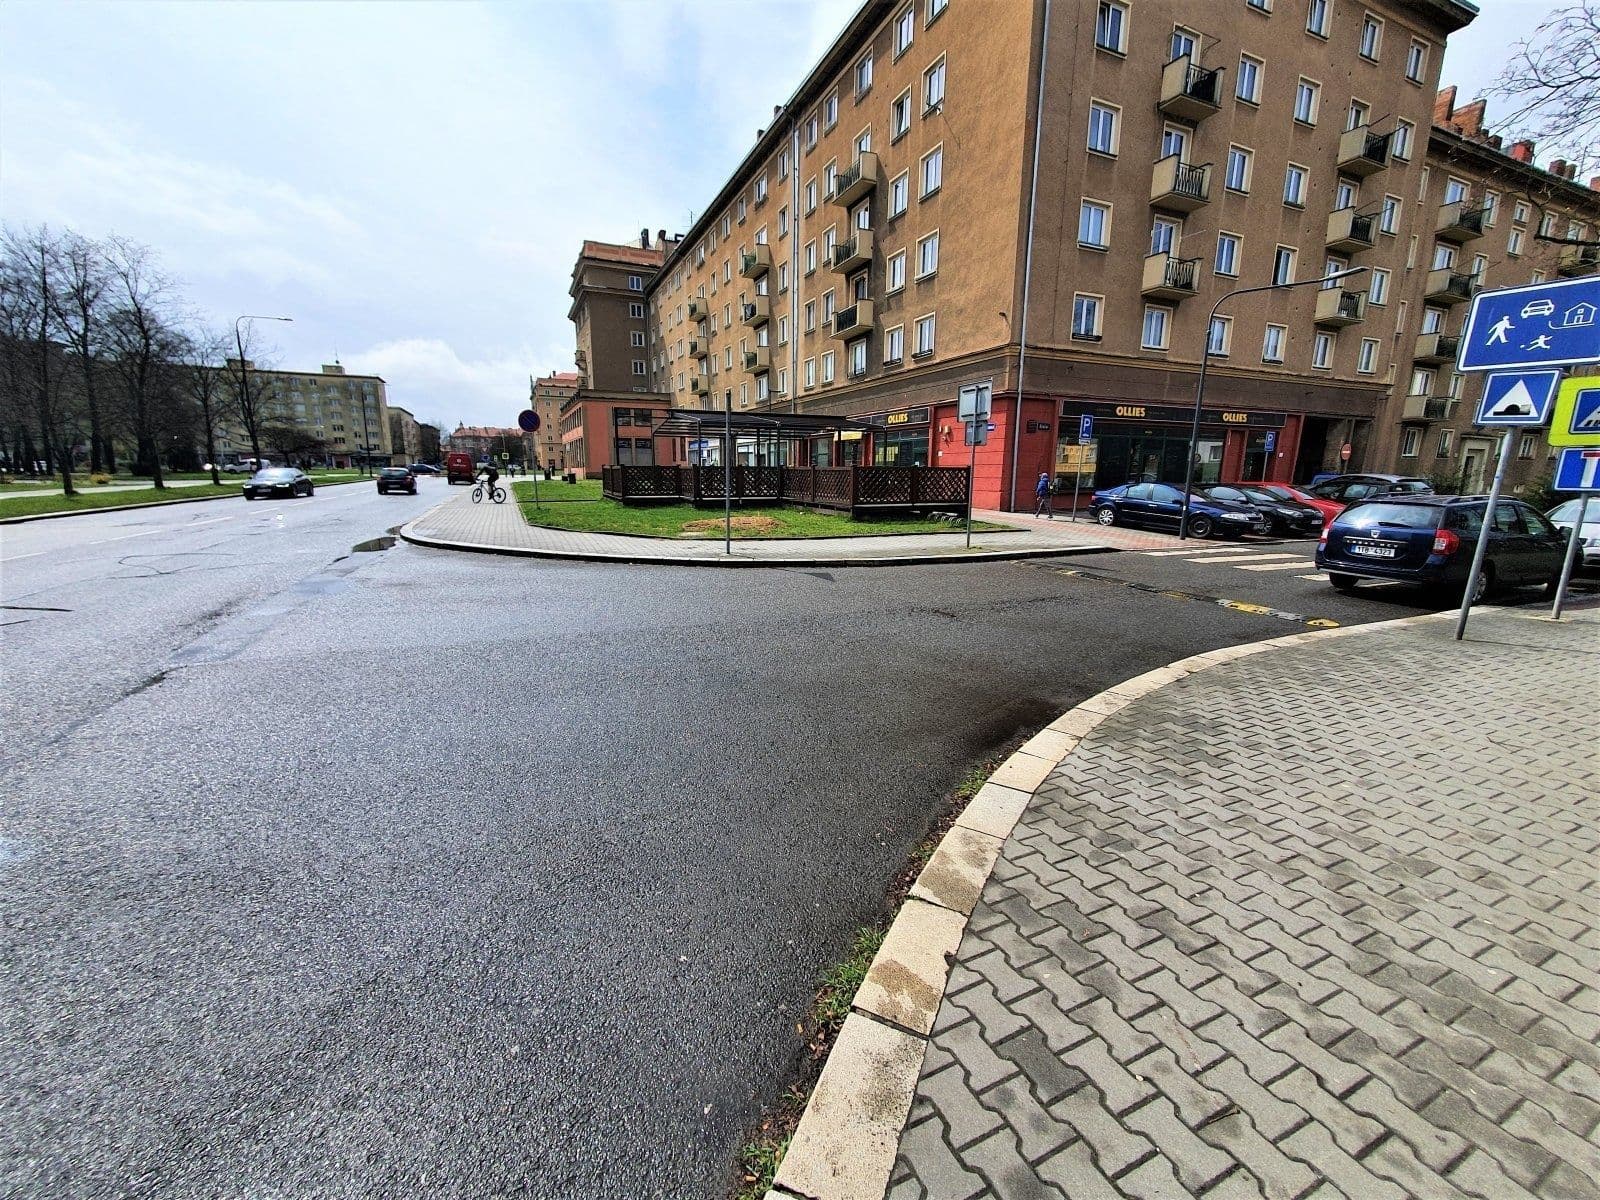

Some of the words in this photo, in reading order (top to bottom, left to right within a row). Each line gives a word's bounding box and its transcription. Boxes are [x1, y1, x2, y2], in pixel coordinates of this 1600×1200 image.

[1116, 406, 1146, 417] OLLIES
[887, 413, 908, 424] OLLIES
[1222, 412, 1248, 423] OLLIES
[1083, 418, 1091, 432] P
